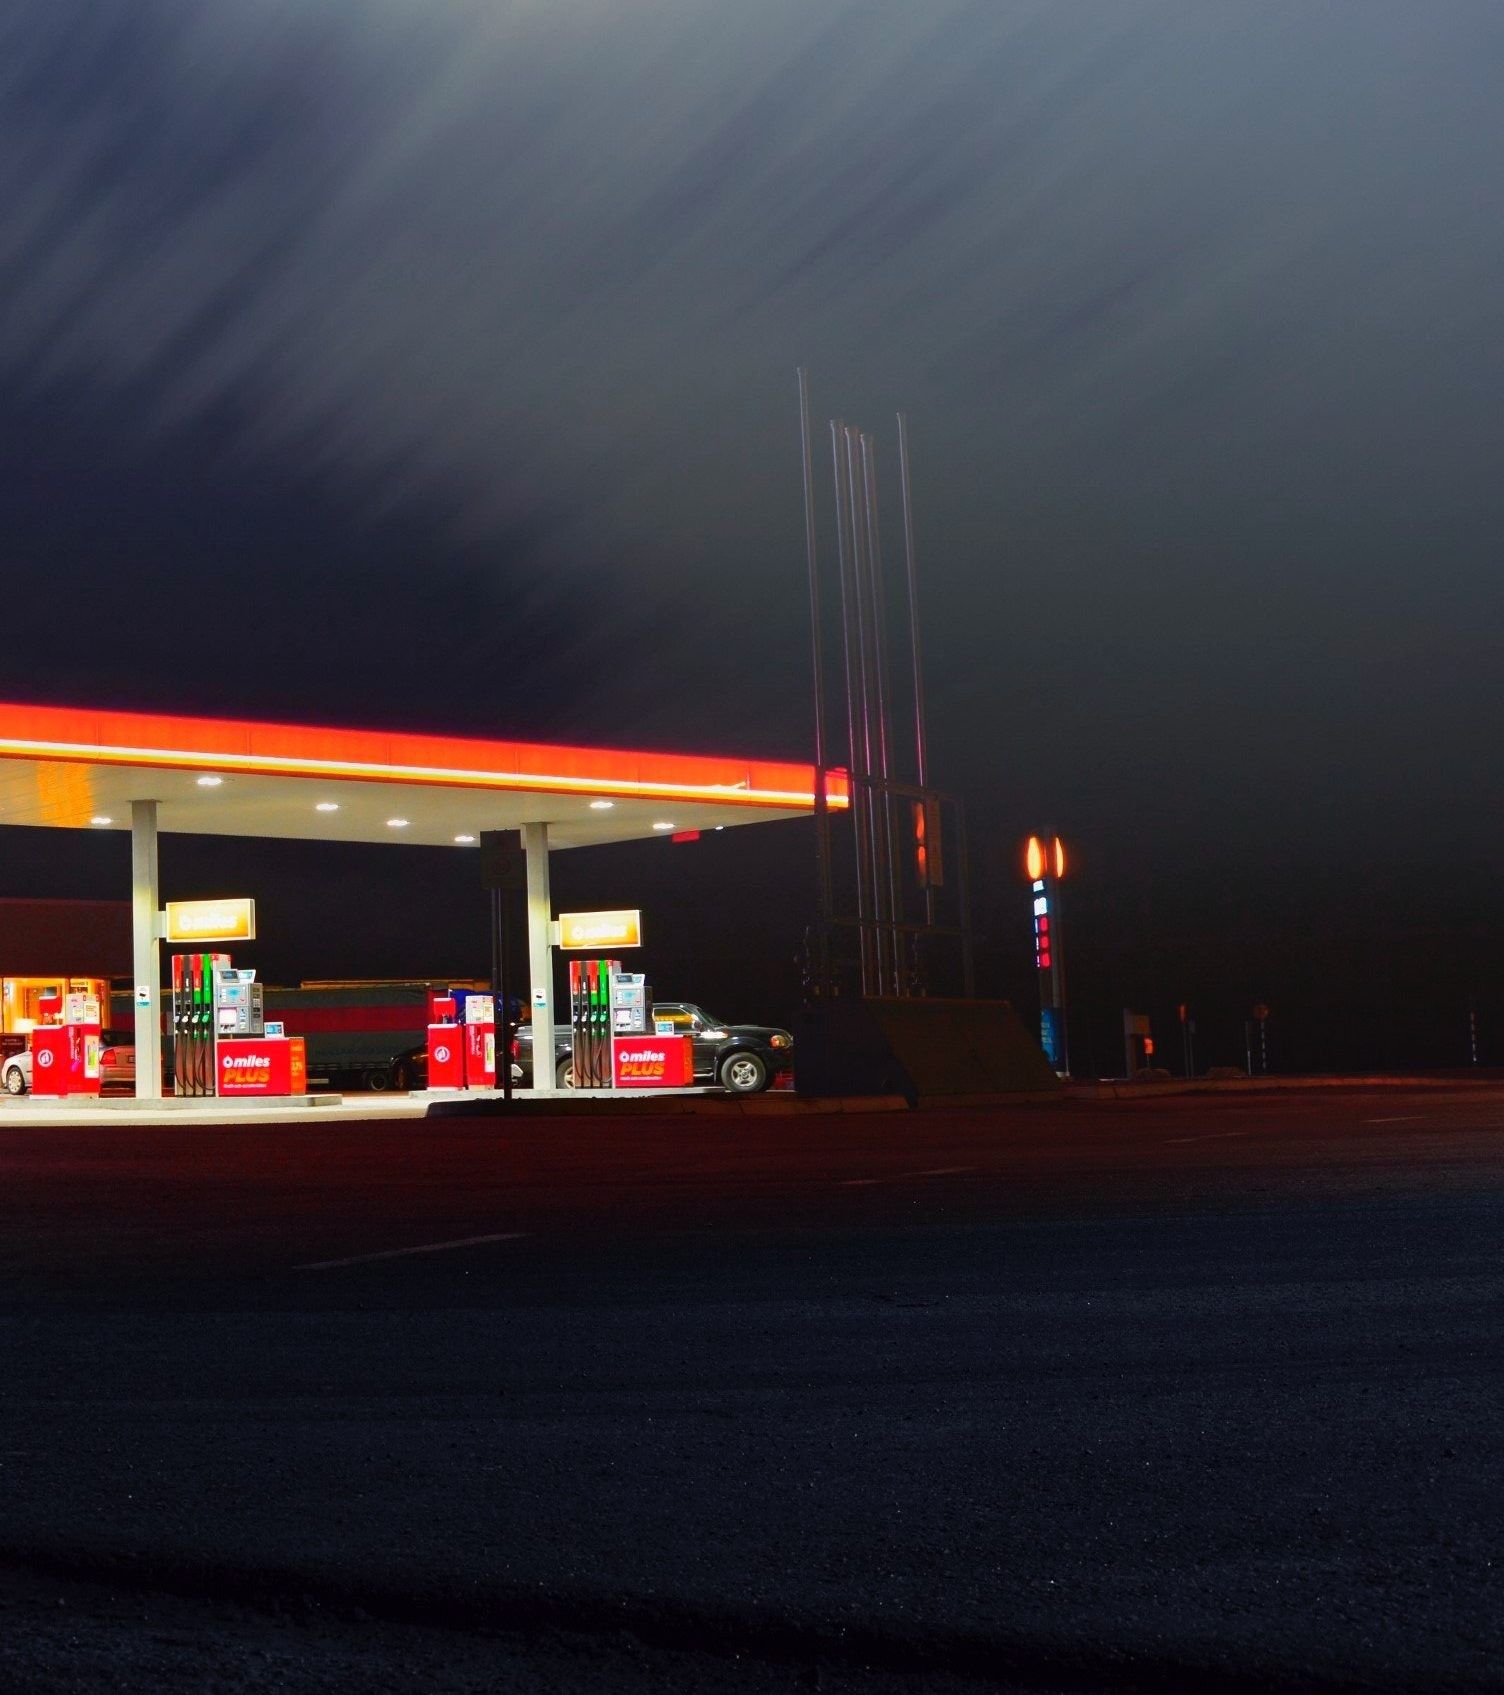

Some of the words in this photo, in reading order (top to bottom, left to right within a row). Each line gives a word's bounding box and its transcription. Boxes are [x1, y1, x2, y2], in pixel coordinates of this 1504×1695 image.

[233, 1055, 271, 1068] miles
[629, 1050, 666, 1062] miles
[223, 1067, 270, 1083] PLUS
[620, 1062, 665, 1076] PLUS
